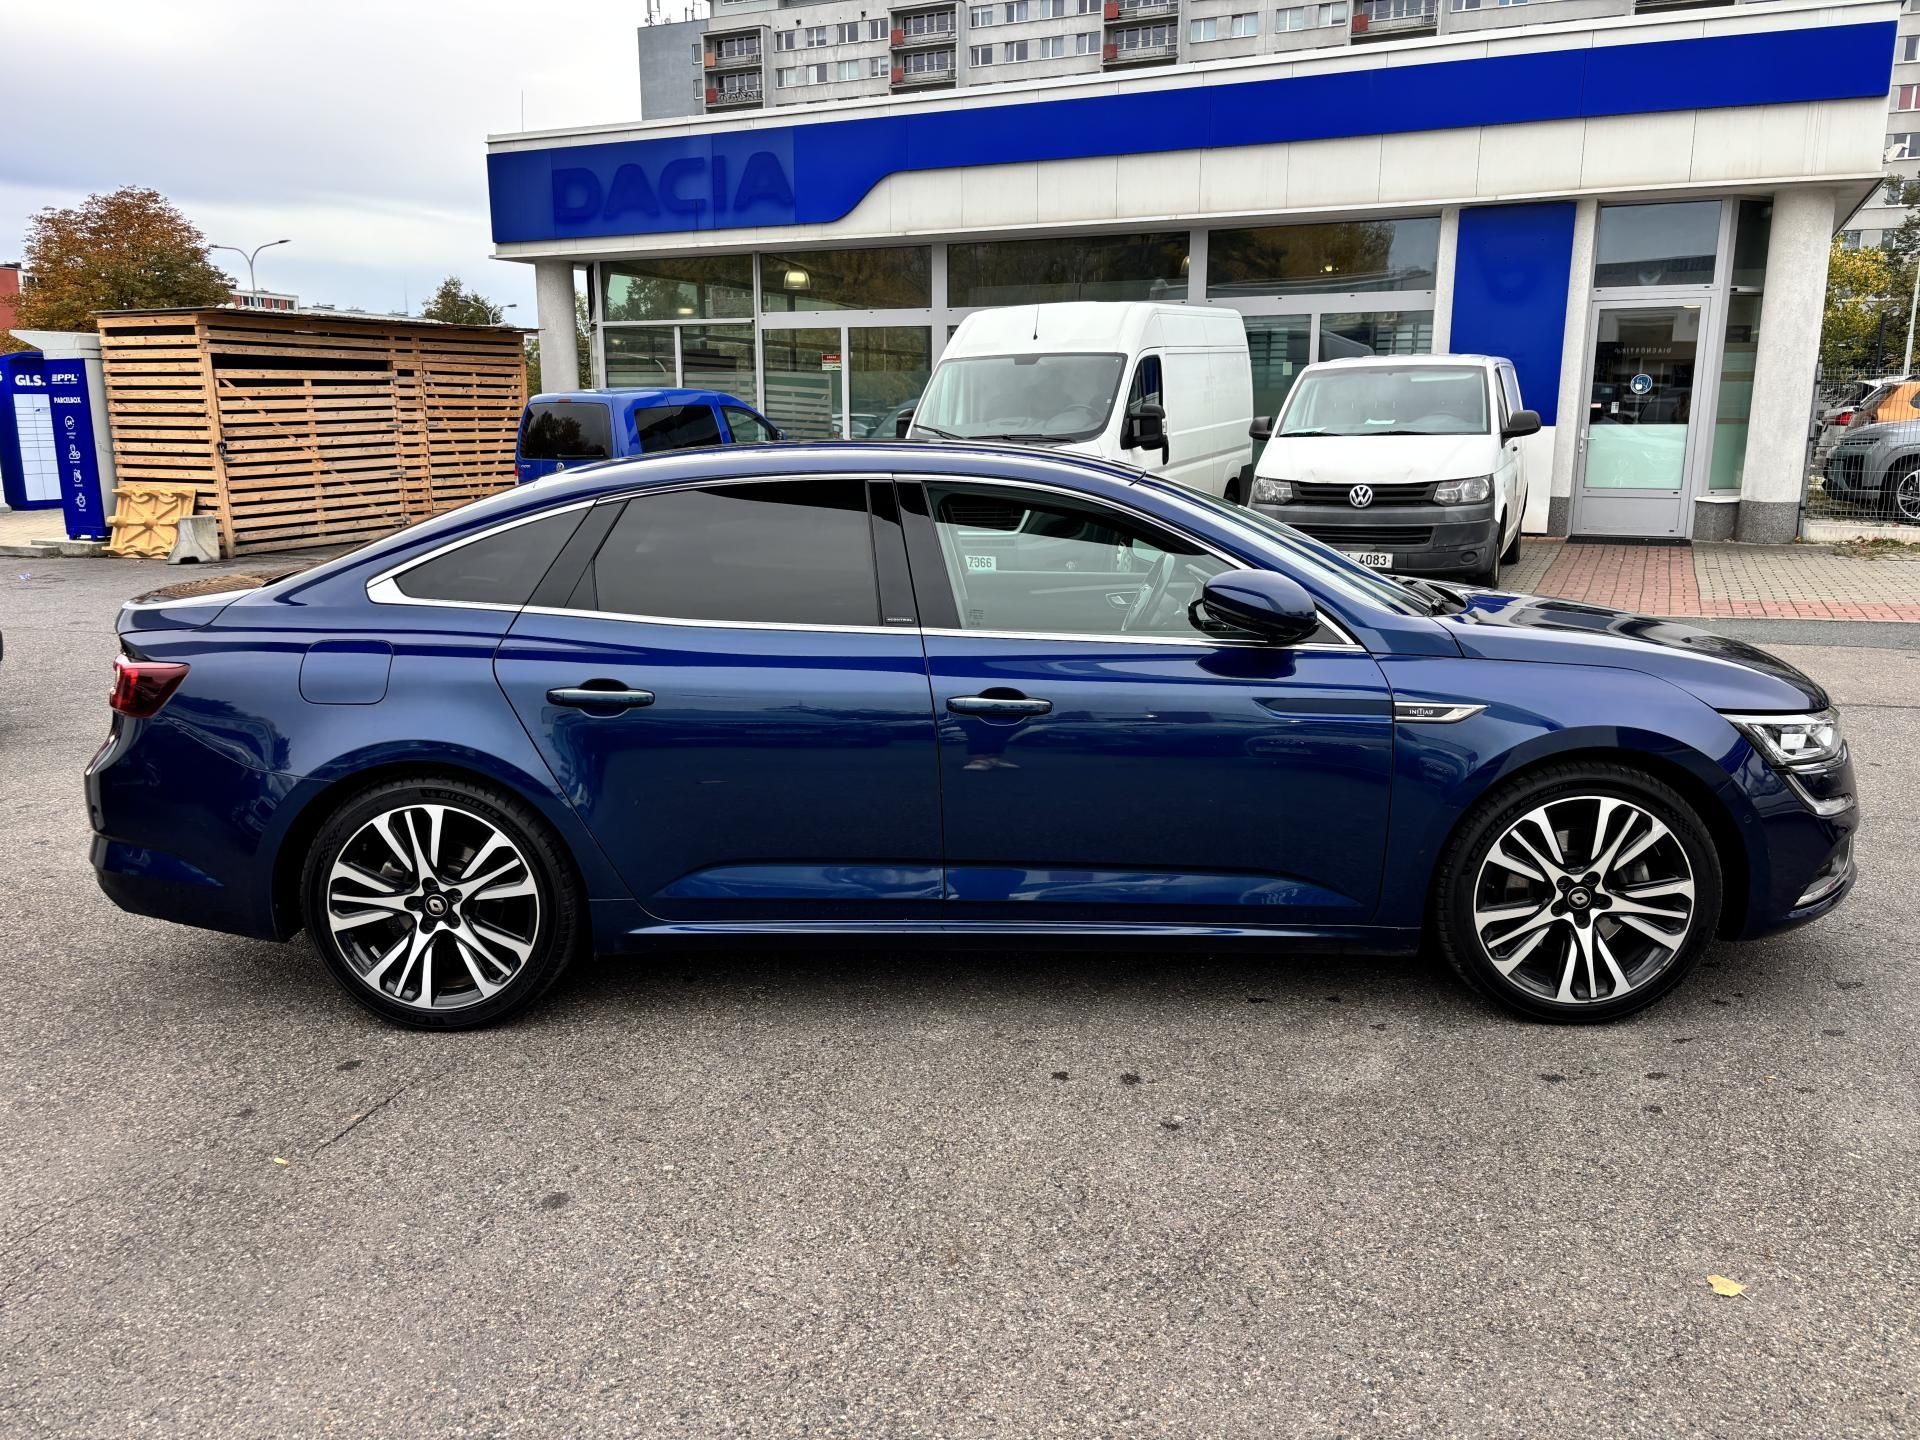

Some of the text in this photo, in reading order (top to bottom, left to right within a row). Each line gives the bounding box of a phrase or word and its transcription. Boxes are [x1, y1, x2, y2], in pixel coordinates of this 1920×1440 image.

[552, 150, 795, 224] DACIA
[1359, 554, 1387, 566] 4083
[440, 791, 501, 818] MICHELIN
